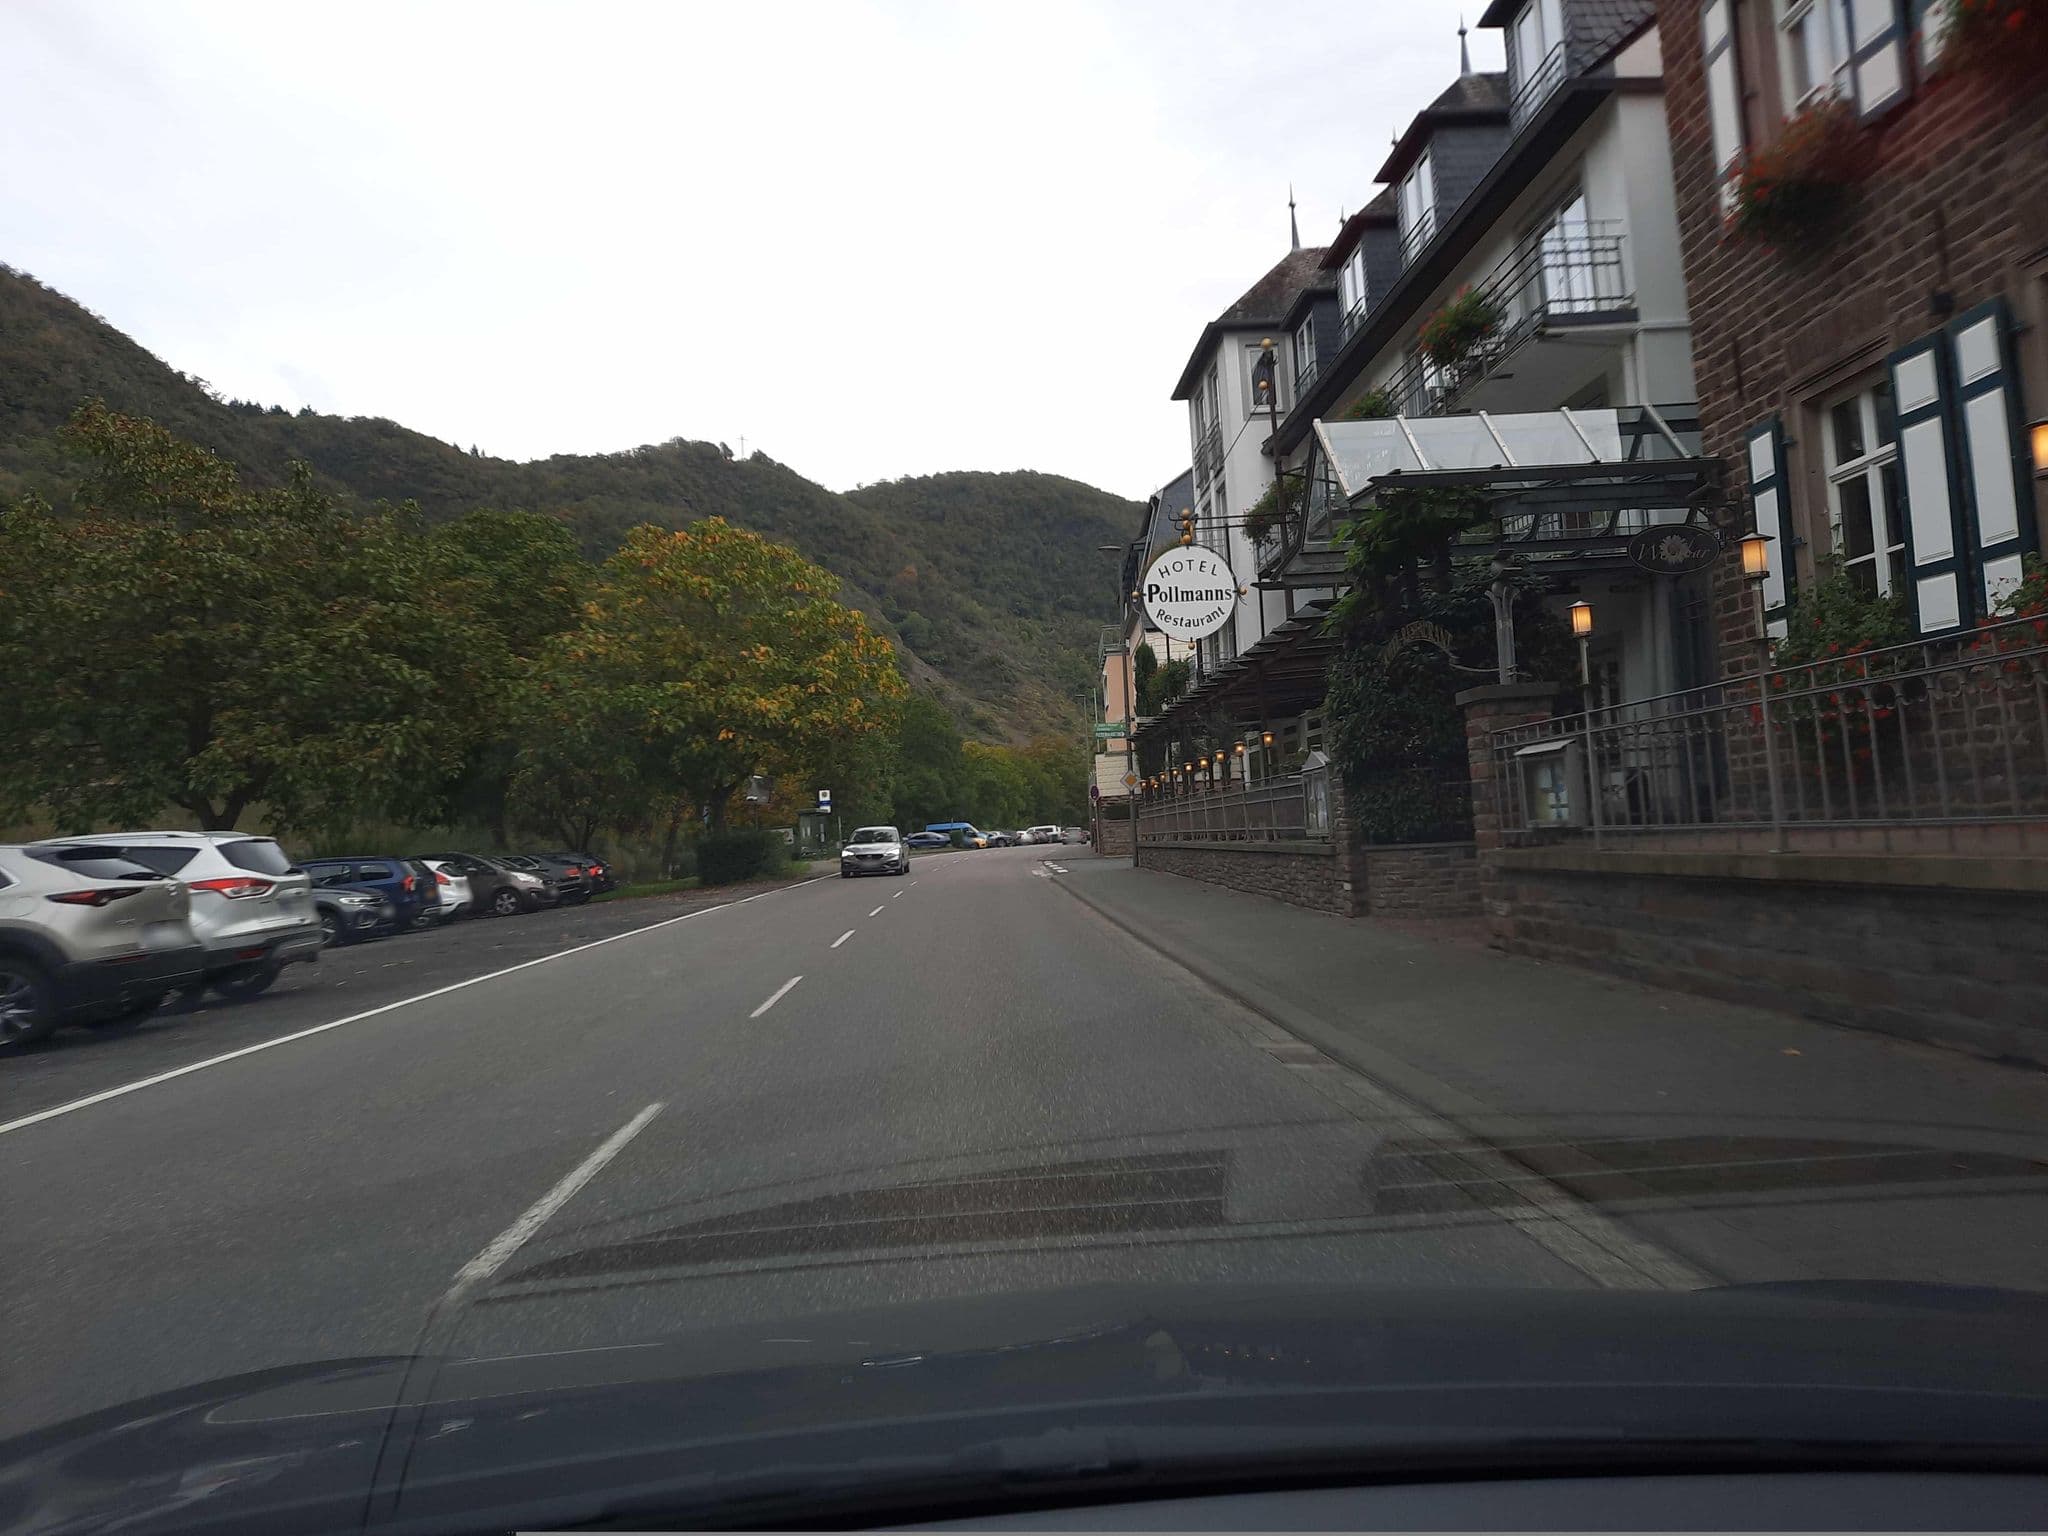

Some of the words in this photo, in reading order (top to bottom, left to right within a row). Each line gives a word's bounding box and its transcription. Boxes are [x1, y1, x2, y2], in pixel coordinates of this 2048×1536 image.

[1158, 559, 1218, 578] HOTEL
[1147, 584, 1232, 603] Pollmanns
[1156, 606, 1225, 628] Restaurant
